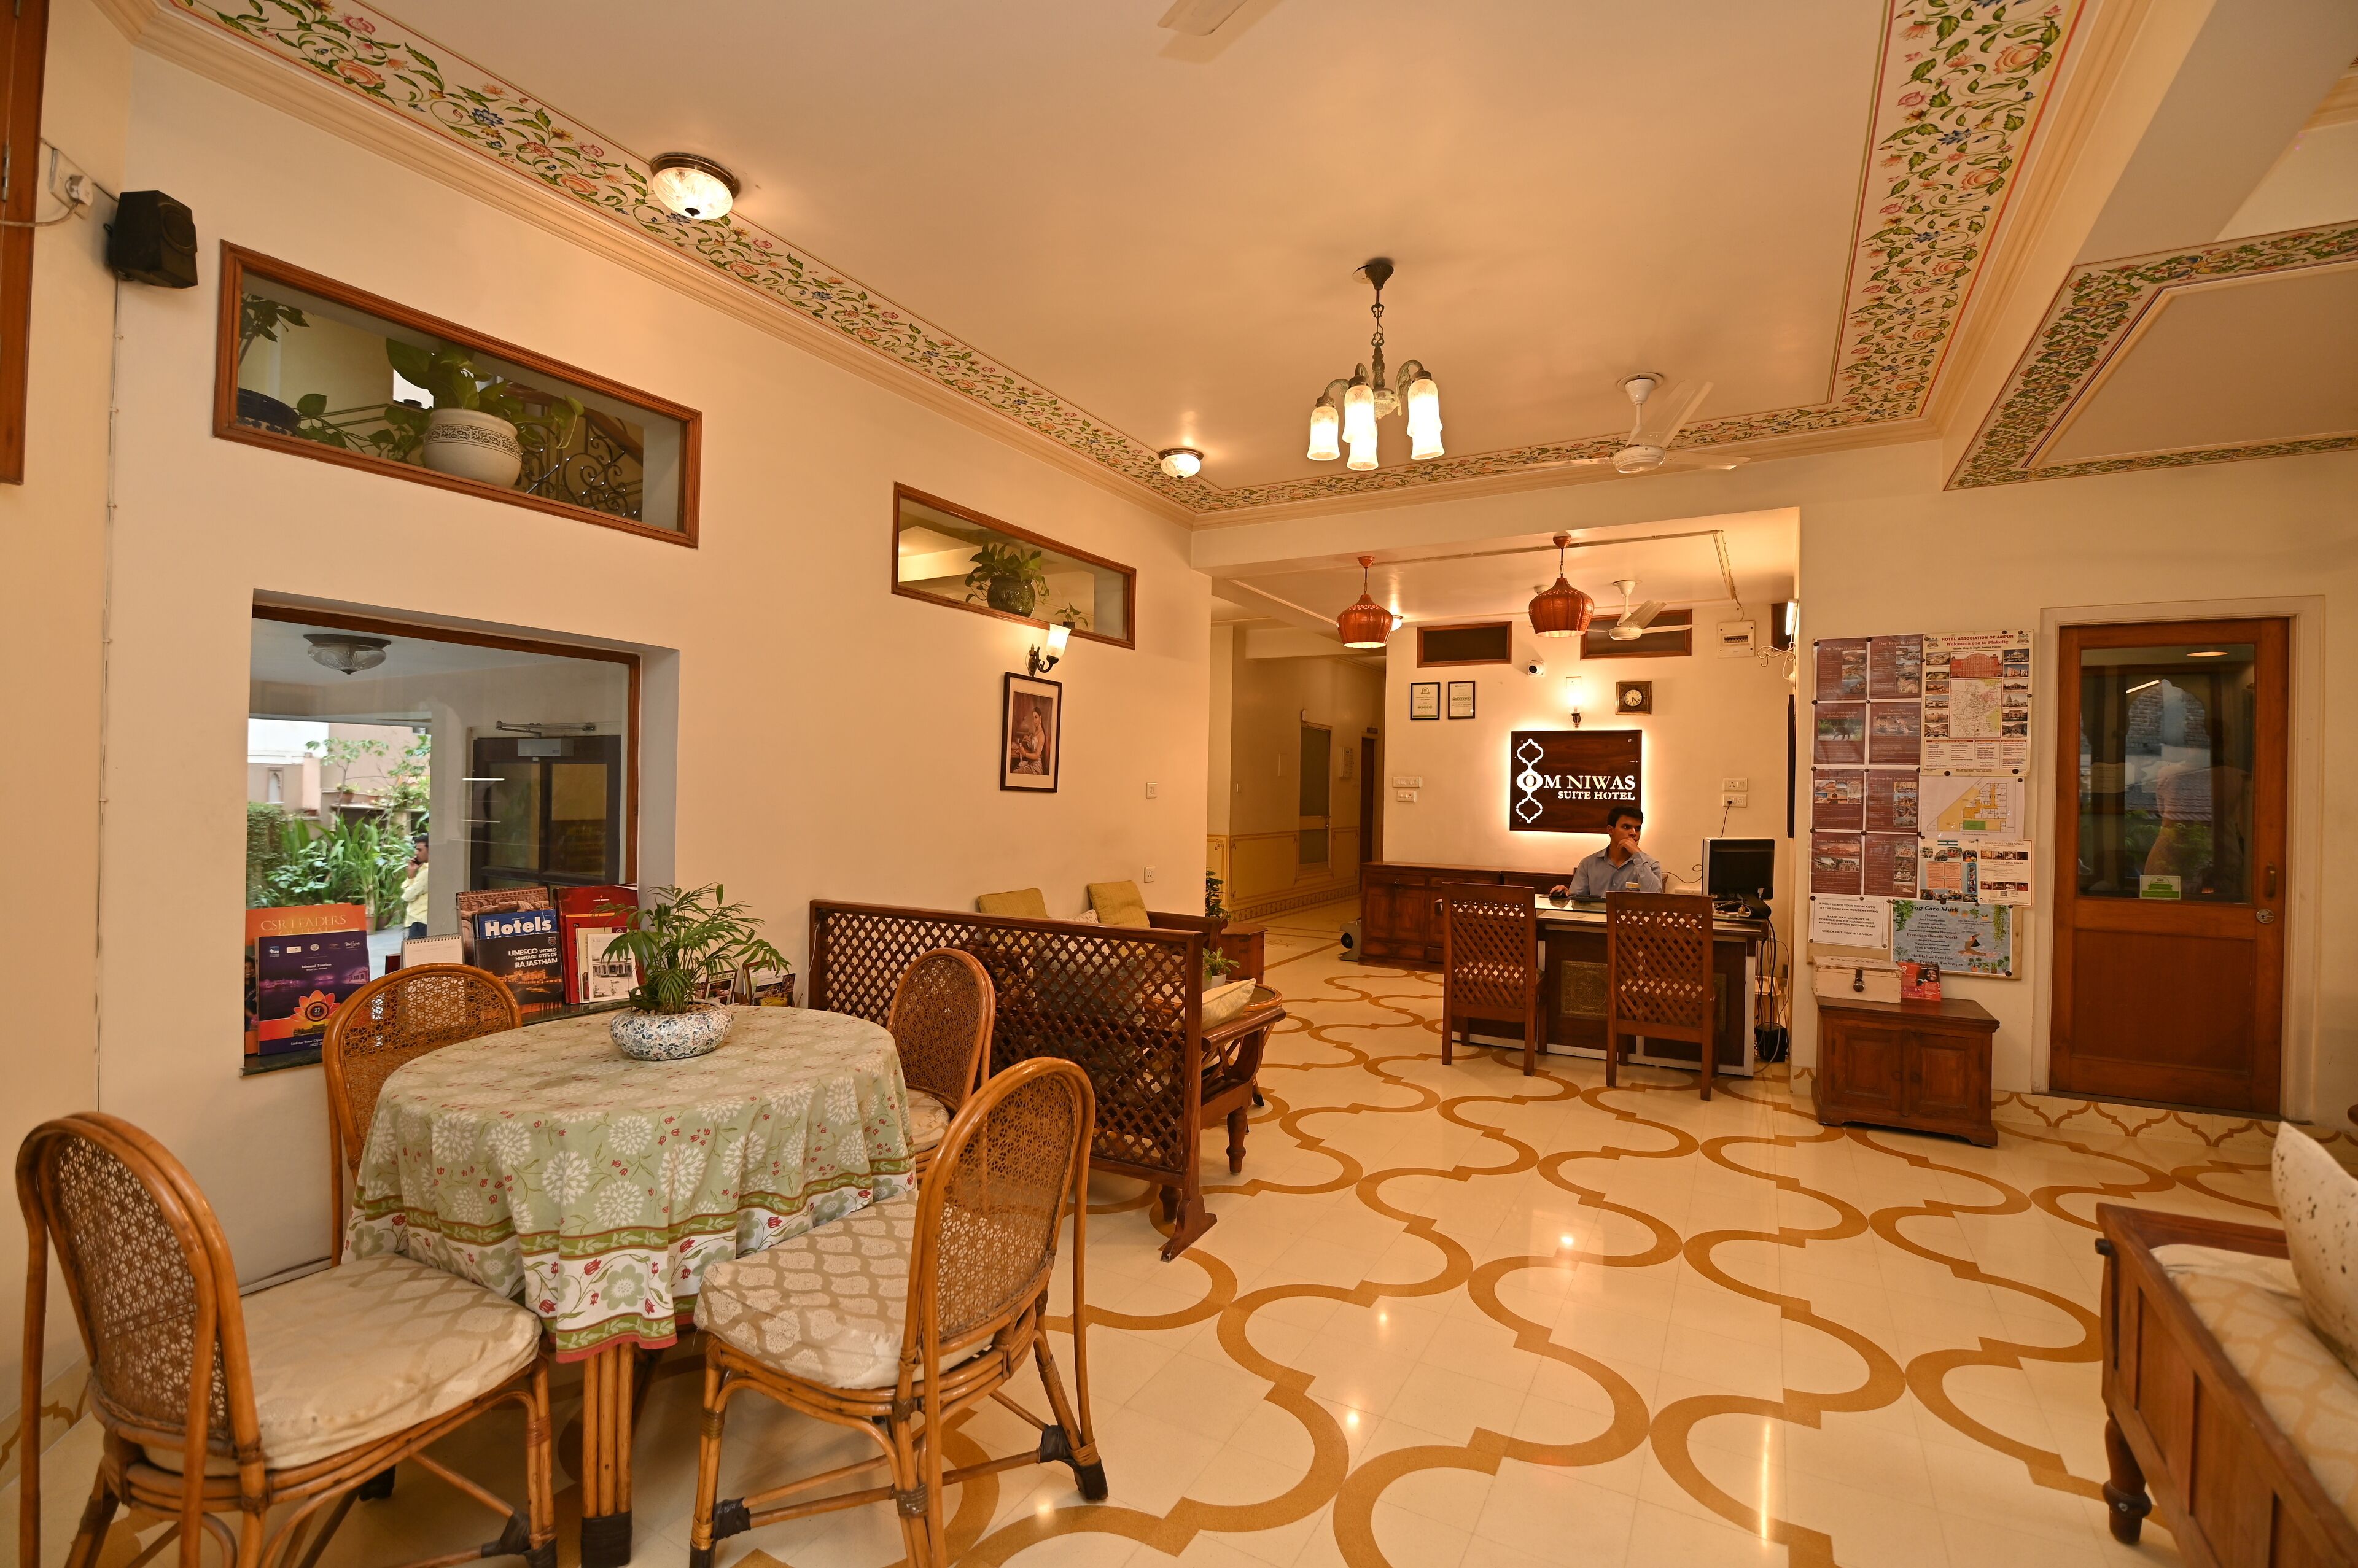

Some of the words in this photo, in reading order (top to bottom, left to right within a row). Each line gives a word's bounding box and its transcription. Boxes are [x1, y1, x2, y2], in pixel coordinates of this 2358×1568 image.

[1523, 775, 1562, 789] OM
[1566, 775, 1636, 790] NIWAS
[1558, 791, 1591, 799] SUITE
[1594, 791, 1635, 800] HOTEL
[260, 920, 286, 931] CSR
[292, 915, 346, 929] LEADERS
[485, 916, 551, 937] Hotels
[508, 948, 538, 957] UNESCO
[515, 958, 558, 968] RAJASTHAN
